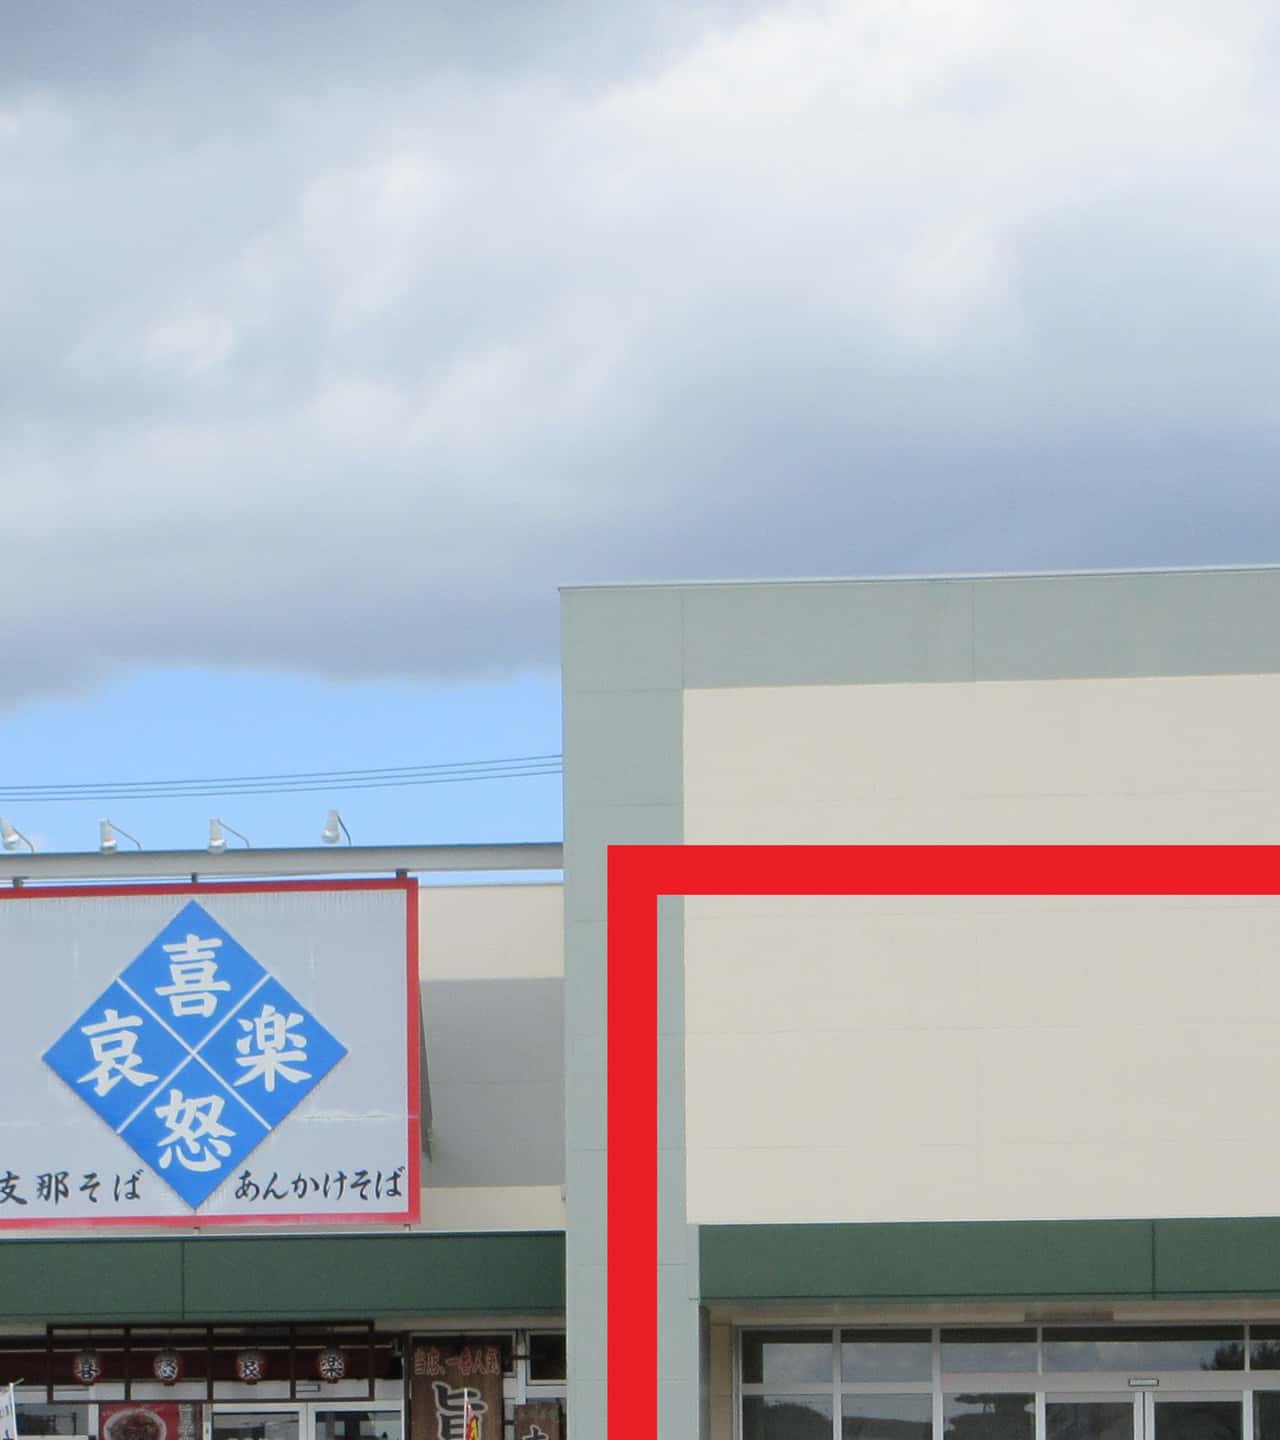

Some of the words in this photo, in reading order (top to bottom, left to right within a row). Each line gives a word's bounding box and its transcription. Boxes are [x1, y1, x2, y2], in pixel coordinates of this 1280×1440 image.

[154, 933, 231, 1018] 喜
[76, 1008, 159, 1097] 哀
[233, 1004, 312, 1093] 楽
[154, 1088, 236, 1172] 怒
[234, 1165, 406, 1202] あんかけそば
